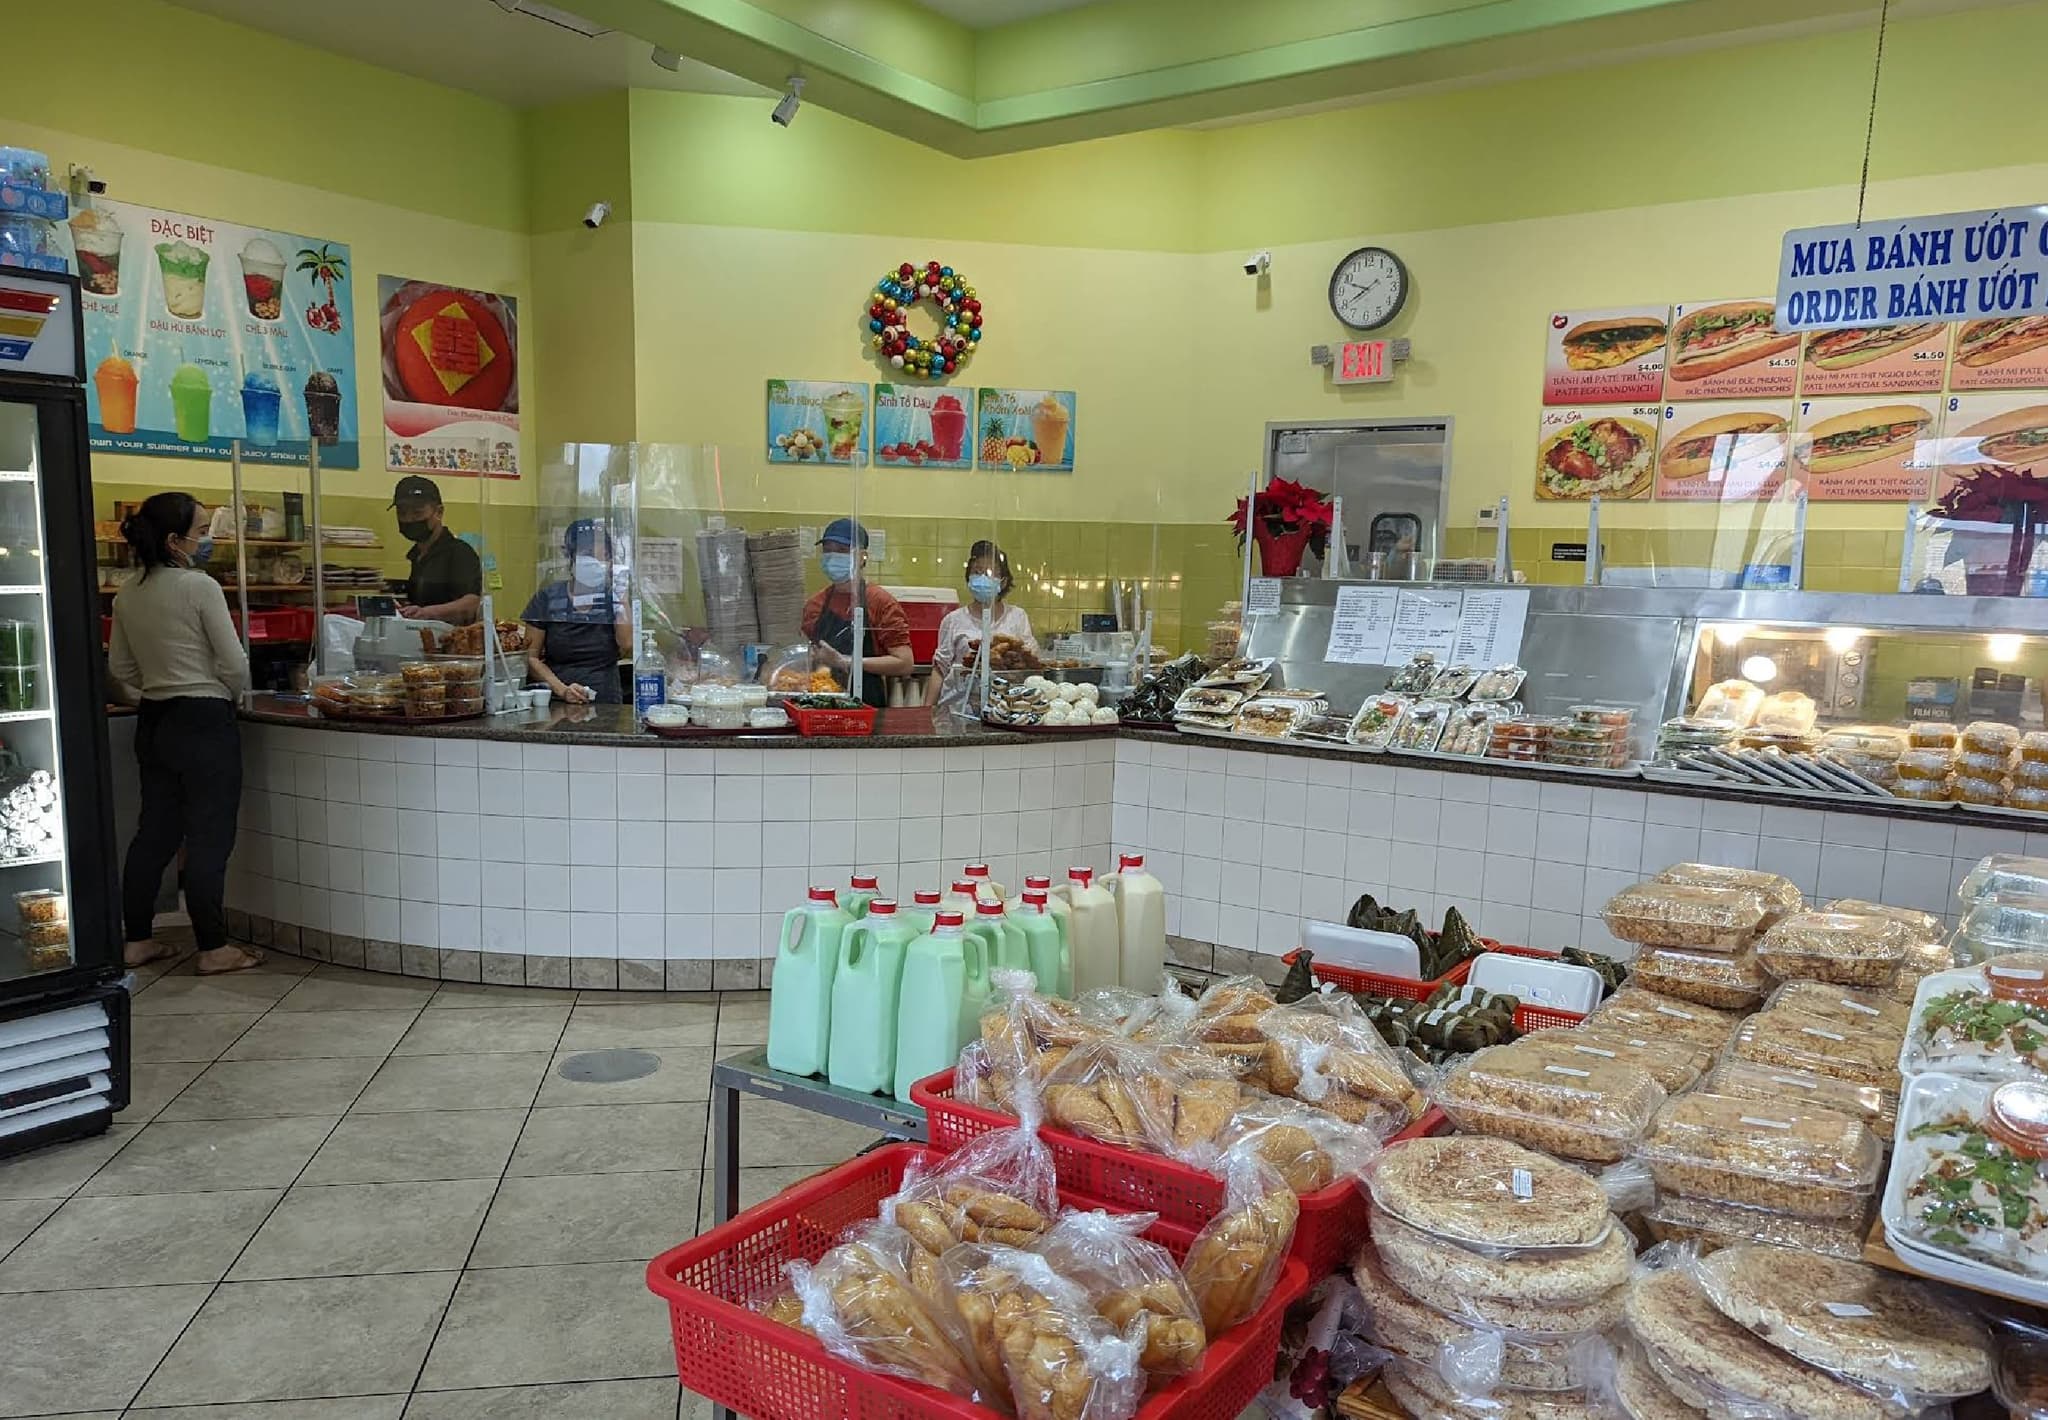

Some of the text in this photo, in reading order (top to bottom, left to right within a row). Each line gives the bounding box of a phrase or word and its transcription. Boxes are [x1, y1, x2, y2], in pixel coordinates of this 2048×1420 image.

[1791, 238, 1855, 277] MUA
[1866, 224, 1953, 271] BÁNH
[1965, 212, 2029, 262] ƯỚT
[1364, 256, 1374, 267] 12
[1380, 258, 1384, 269] 1
[1353, 262, 1360, 272] 11
[1386, 268, 1392, 278] 2
[1344, 273, 1353, 284] 10
[1338, 286, 1344, 296] 9
[1390, 281, 1397, 292] 3
[1788, 262, 2038, 325] ORDER BÁNH ƯỚT
[1341, 299, 1348, 309] 8
[1385, 295, 1391, 305] 4
[1350, 308, 1357, 318] 7
[1375, 306, 1381, 316] 5
[1676, 305, 1682, 316] 1
[1363, 311, 1369, 321] 6
[1342, 341, 1385, 378] EXIT
[1913, 352, 1944, 360] $4.50
[1768, 359, 1796, 367] $4.50
[1601, 384, 1654, 394] SANDWICH
[1738, 385, 1791, 393] SANDWICHES
[1825, 382, 1848, 390] HAM
[1848, 381, 1880, 389] SPECIAL
[1882, 379, 1940, 388] SANDWICHES
[1801, 402, 1811, 415] 7
[1948, 398, 1959, 412] 8
[1632, 407, 1659, 415] $5.00
[1665, 406, 1674, 419] 6
[116, 440, 144, 449] YOUR
[147, 442, 189, 452] SUMMER
[192, 446, 216, 454] WITH
[1847, 488, 1868, 496] HAM
[1870, 487, 1927, 495] SANDWICHES
